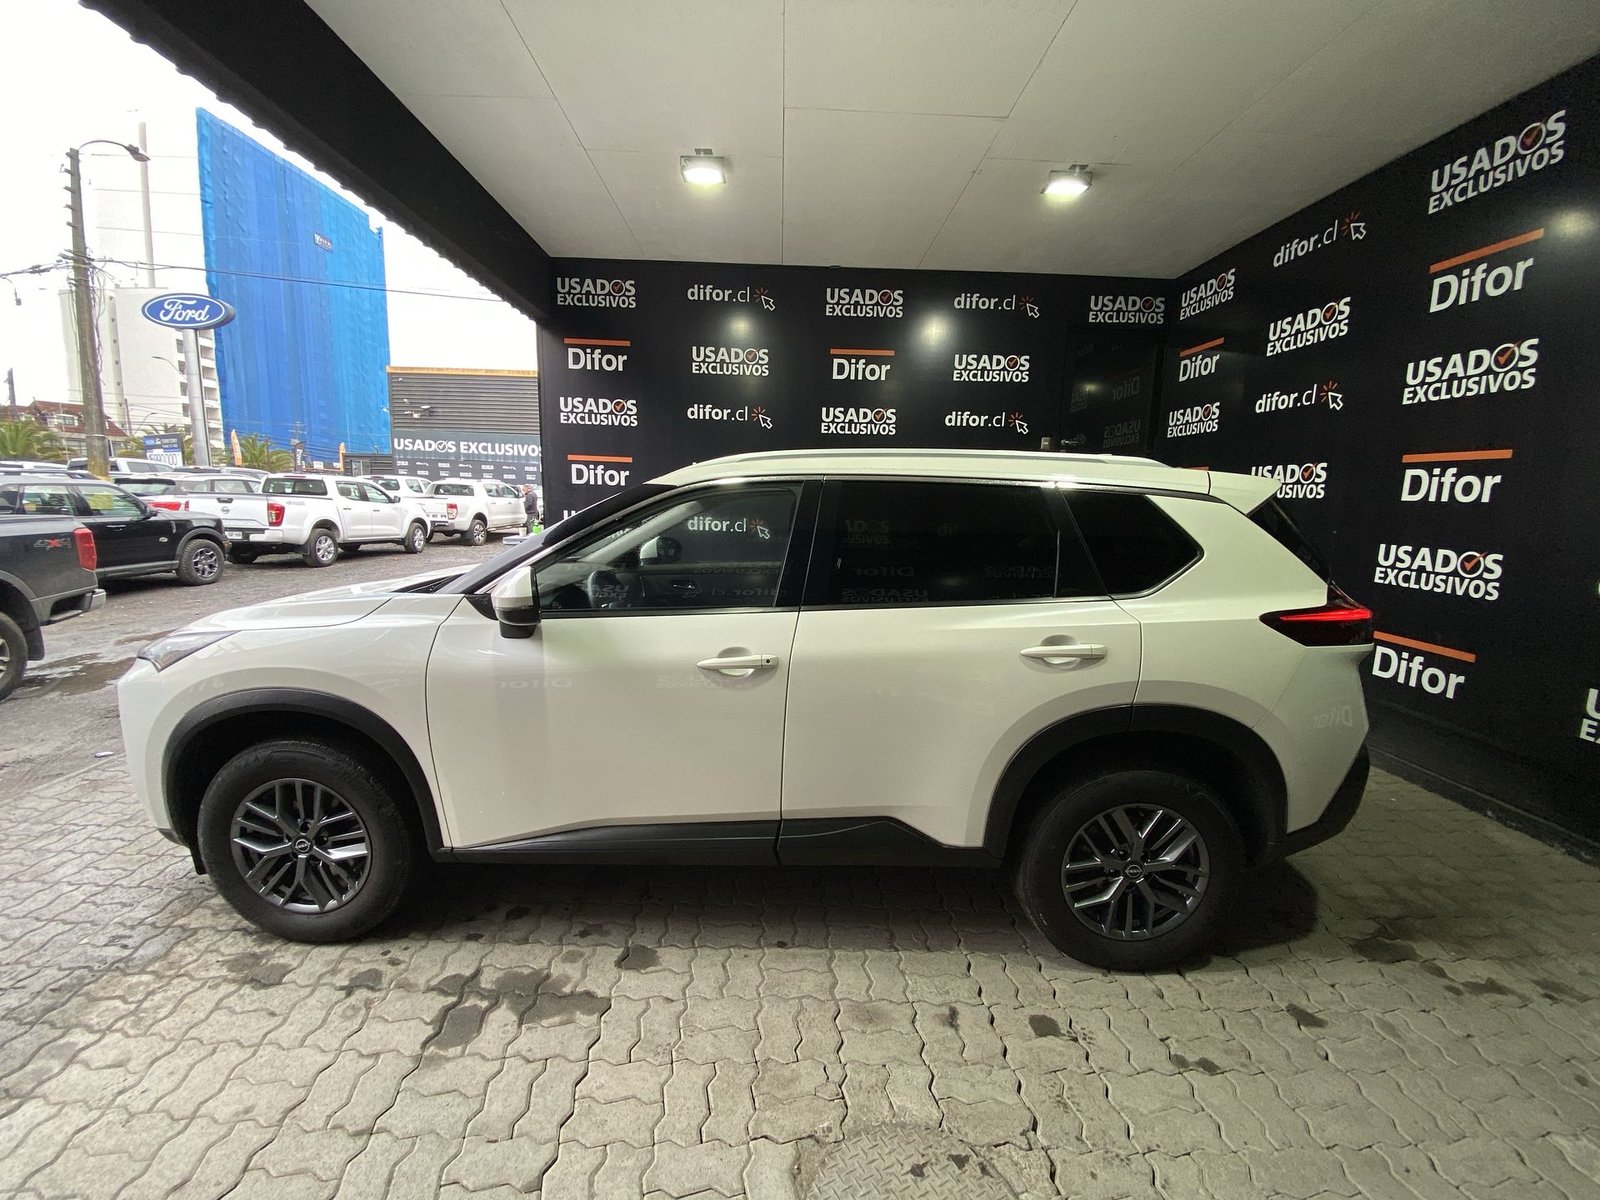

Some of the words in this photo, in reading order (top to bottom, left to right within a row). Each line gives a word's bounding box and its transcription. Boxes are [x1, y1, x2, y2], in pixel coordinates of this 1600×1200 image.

[1430, 109, 1566, 193] USADOS
[1427, 140, 1565, 215] EXCLUSIVOS
[1273, 219, 1338, 268] difor.cl
[556, 277, 636, 296] USADOS
[687, 284, 750, 303] difor.cl
[1181, 268, 1236, 308] USADOS
[1429, 257, 1534, 313] Difor
[557, 294, 636, 309] EXCLUSIVOS
[826, 287, 903, 306] USADOS
[953, 293, 1015, 311] difor.cl
[1090, 295, 1165, 313] USADOS
[1180, 286, 1234, 321] EXCLUSIVOS
[159, 298, 210, 322] Ford
[825, 304, 903, 318] EXCLUSIVOS
[1088, 311, 1165, 325] EXCLUSIVOS
[1269, 297, 1351, 342] USADOS
[1266, 319, 1349, 357] EXCLUSIVOS
[567, 347, 627, 372] Difor
[691, 346, 769, 365] USADOS
[954, 354, 1030, 371] USADOS
[1405, 338, 1540, 386] USADOS
[692, 362, 769, 377] EXCLUSIVOS
[832, 358, 890, 381] Difor
[953, 370, 1029, 383] EXCLUSIVOS
[1178, 353, 1220, 383] Difor
[1401, 367, 1536, 406] EXCLUSIVOS
[559, 396, 638, 415] USADOS
[1255, 384, 1317, 414] difor.cl
[560, 412, 638, 427] EXCLUSIVOS
[687, 404, 748, 422] difor.cl
[821, 407, 896, 424] USADOS
[944, 411, 1005, 428] difor.cl
[1169, 401, 1220, 427] USADOS
[821, 422, 896, 436] EXCLUSIVOS
[1167, 419, 1219, 439] EXCLUSIVOS
[393, 438, 456, 453] USADOS
[460, 441, 542, 457] EXCLUSIVO
[571, 463, 630, 487] Difor
[1401, 467, 1501, 503] Difor
[687, 516, 747, 533] difor.cl
[1377, 543, 1504, 580] USADOS
[1373, 567, 1500, 601] EXCLUSIVOS
[1372, 645, 1465, 700] Difor
